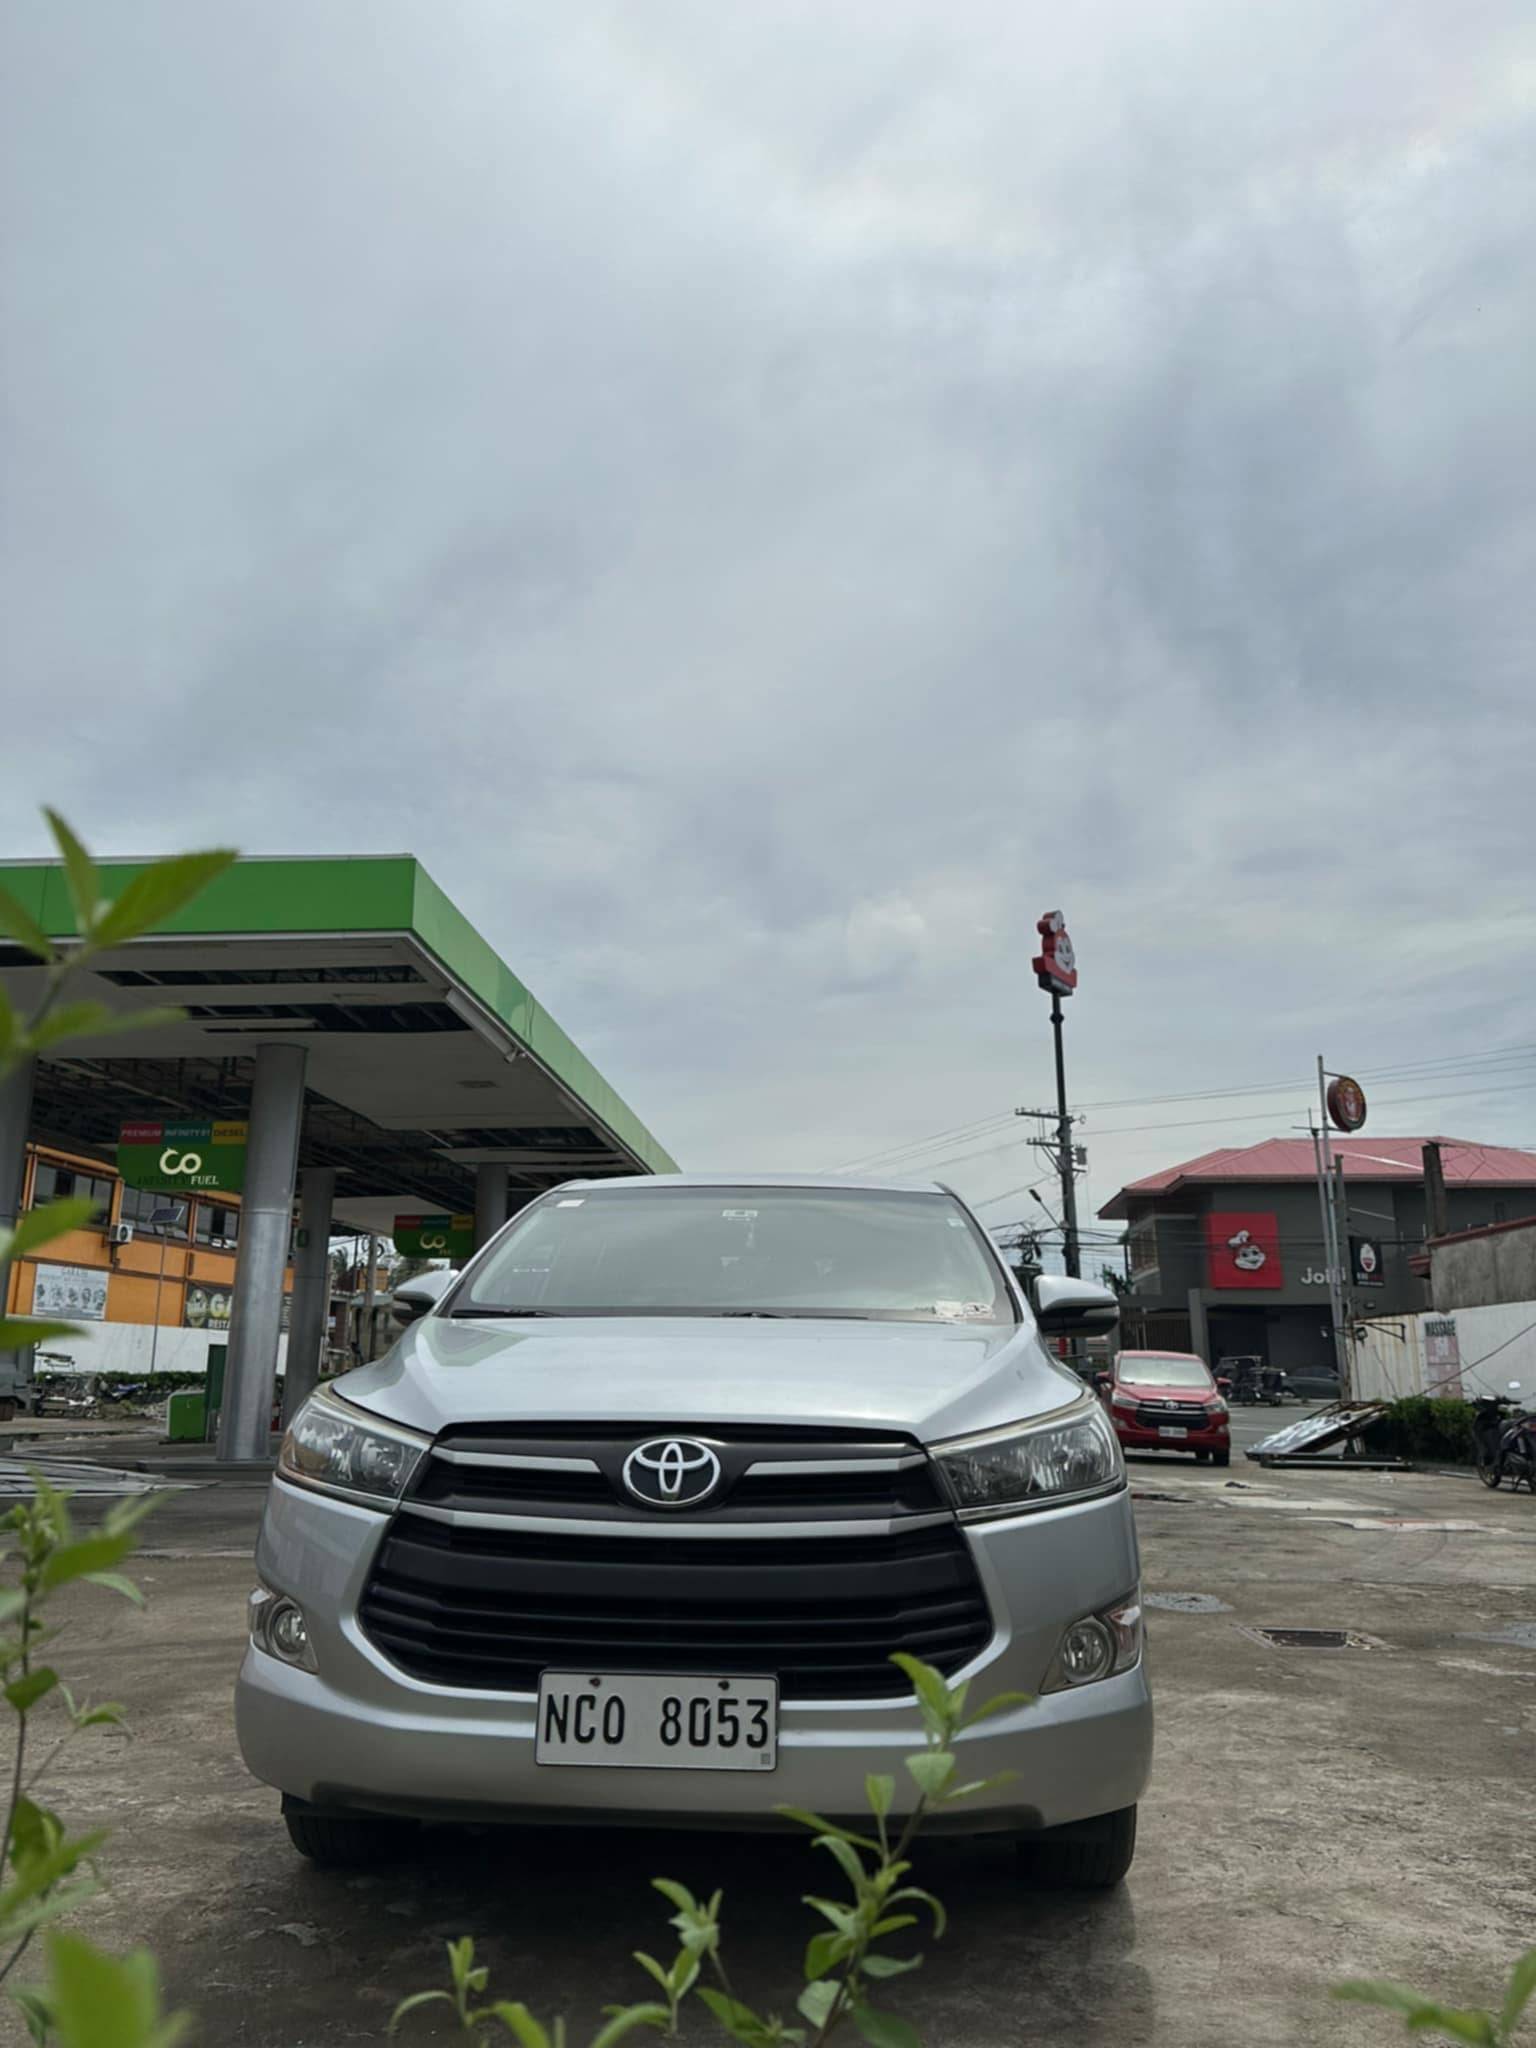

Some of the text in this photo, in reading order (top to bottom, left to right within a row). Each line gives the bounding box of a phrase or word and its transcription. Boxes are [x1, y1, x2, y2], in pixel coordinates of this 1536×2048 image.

[121, 1128, 162, 1137] PREMIUM
[190, 1175, 220, 1185] FUEL
[544, 1693, 769, 1749] NCO 8053
